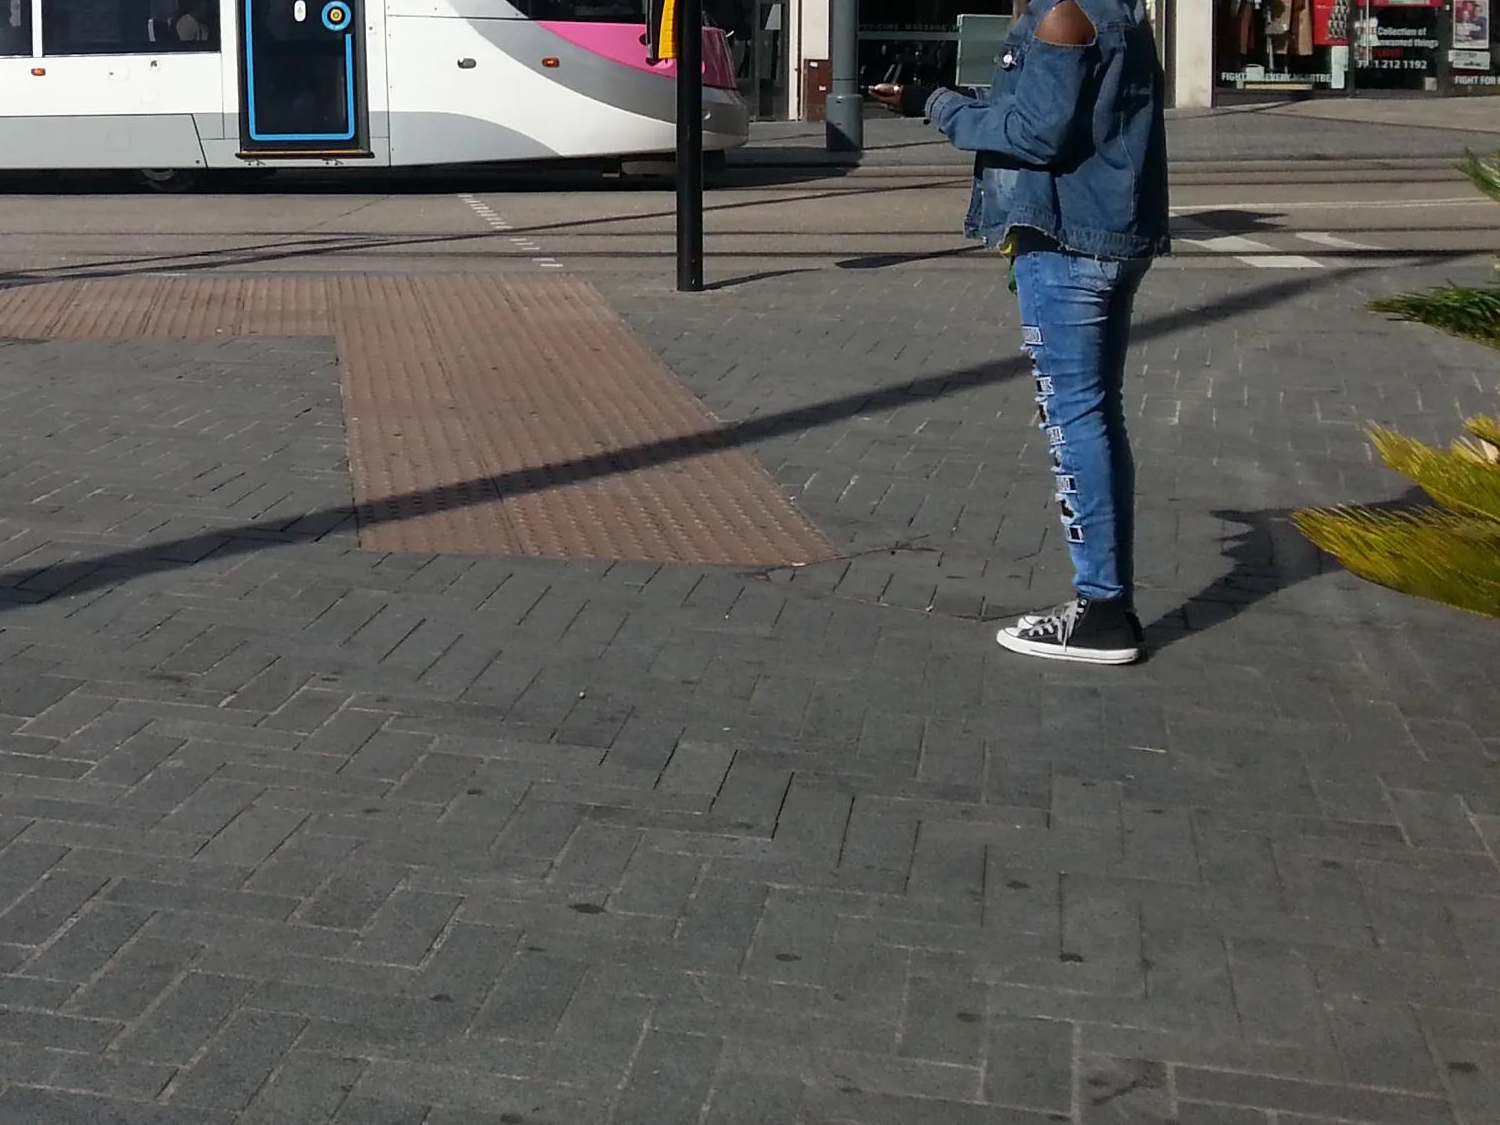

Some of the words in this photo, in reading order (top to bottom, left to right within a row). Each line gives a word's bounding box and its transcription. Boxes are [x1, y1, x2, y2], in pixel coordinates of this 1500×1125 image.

[1402, 59, 1428, 70] 1192
[1454, 75, 1479, 85] FIGHT
[1479, 75, 1496, 85] FOR
